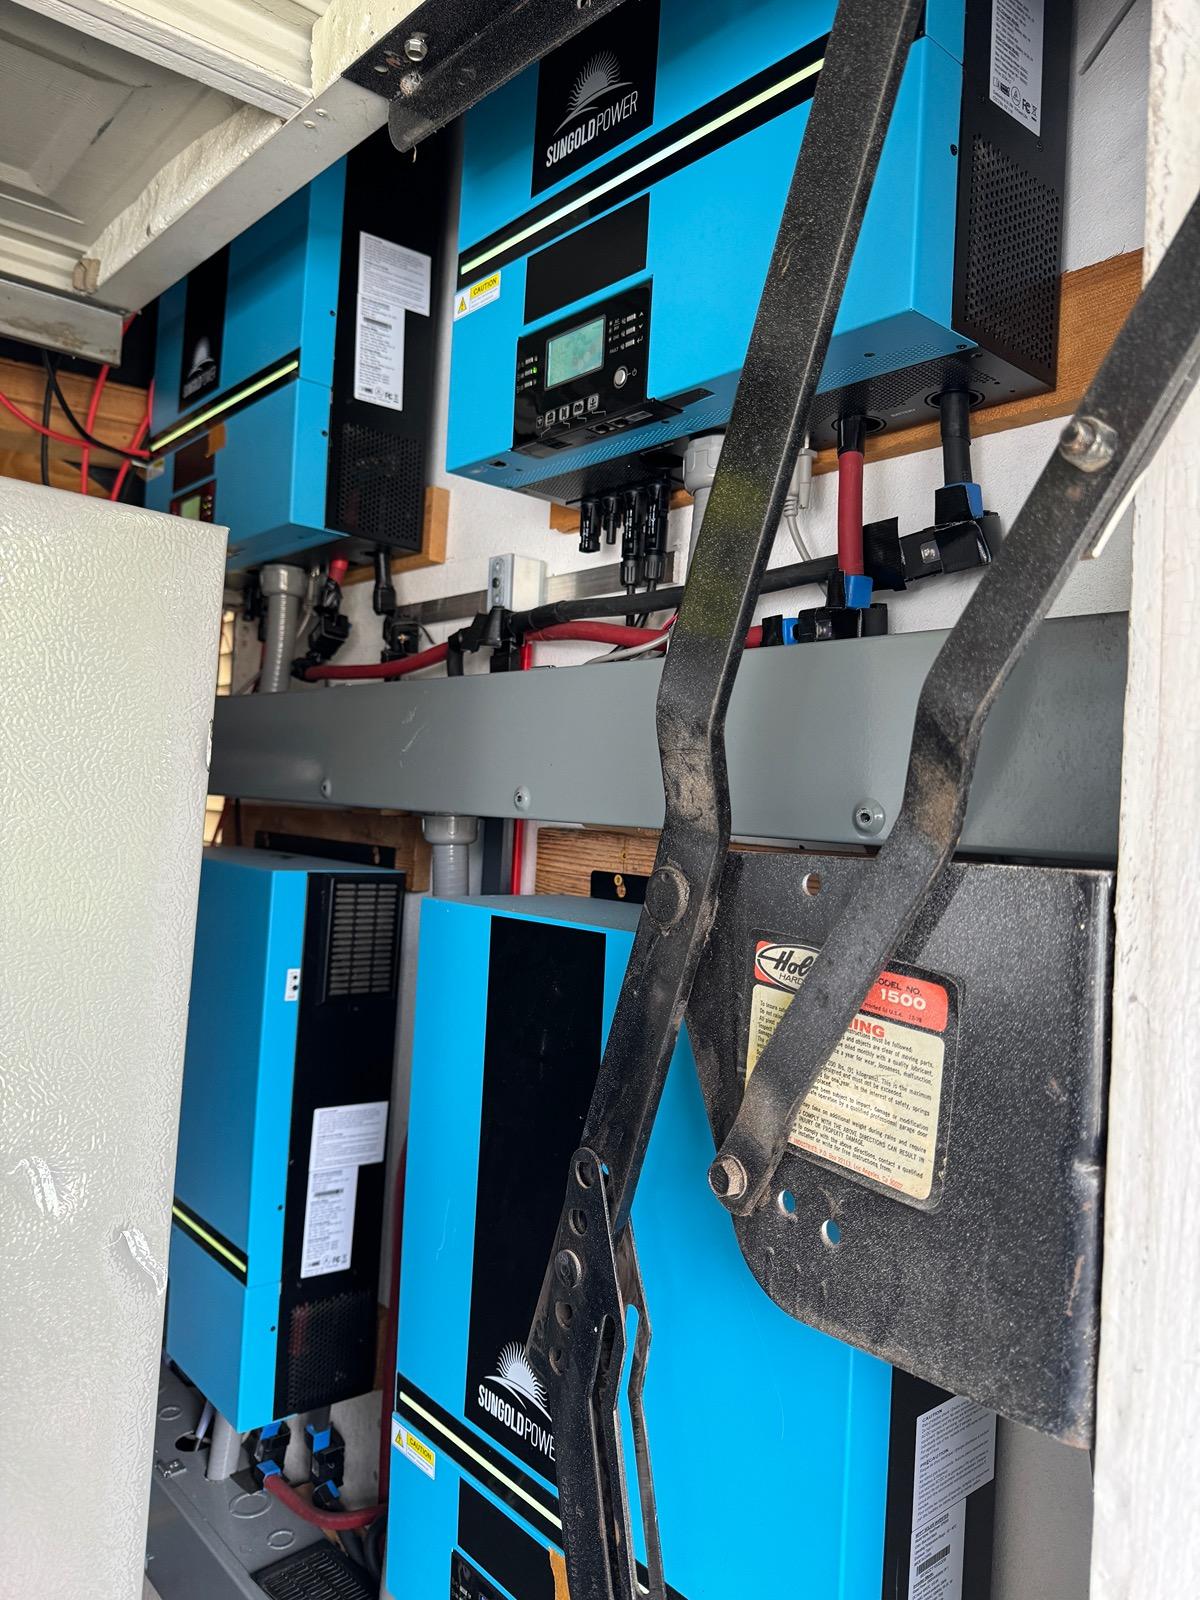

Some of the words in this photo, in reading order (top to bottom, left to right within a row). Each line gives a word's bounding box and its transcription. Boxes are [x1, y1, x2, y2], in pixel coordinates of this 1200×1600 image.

[473, 277, 498, 296] CAUTION
[758, 950, 814, 977] Hol
[778, 971, 805, 986] HARD
[880, 988, 927, 1012] 1500
[844, 1042, 855, 1051] oiled
[857, 1046, 874, 1058] monthly
[876, 1052, 886, 1061] with
[892, 1057, 909, 1069] quality
[844, 1052, 854, 1060] year
[855, 1038, 871, 1048] objects
[881, 1046, 893, 1054] clear
[902, 1052, 918, 1063] moving
[842, 1071, 851, 1079] and
[851, 1075, 862, 1083] must
[869, 1089, 887, 1100] interest
[912, 1105, 930, 1117] springs
[899, 1084, 907, 1092] the
[909, 1087, 931, 1100] maximum
[874, 1106, 890, 1118] damage
[802, 1110, 819, 1121] COMPLY
[820, 1117, 832, 1126] WITH
[833, 1122, 842, 1130] THE
[843, 1126, 857, 1137] ABOVE
[859, 1132, 886, 1148] DIRECTIONS
[887, 1143, 897, 1153] CAN
[898, 1148, 916, 1160] RESULT
[918, 1156, 925, 1164] IN
[822, 1124, 844, 1138] PROPERTY
[829, 1111, 850, 1123] additional
[852, 1120, 866, 1131] weight
[868, 1126, 883, 1138] during
[899, 1138, 907, 1146] and
[909, 1142, 926, 1154] require
[898, 1123, 915, 1134] garage
[917, 1129, 928, 1138] door
[803, 1125, 818, 1137] comply
[819, 1132, 829, 1140] with
[839, 1140, 852, 1150] above
[878, 1156, 895, 1168] contact
[902, 1165, 923, 1180] qualified
[841, 1147, 851, 1156] free
[478, 1384, 556, 1462] SUNGOLDPOWE
[922, 1409, 943, 1422] CAUTION
[410, 1438, 432, 1461] CAUTION
[919, 1447, 950, 1469] PRECAUTION
